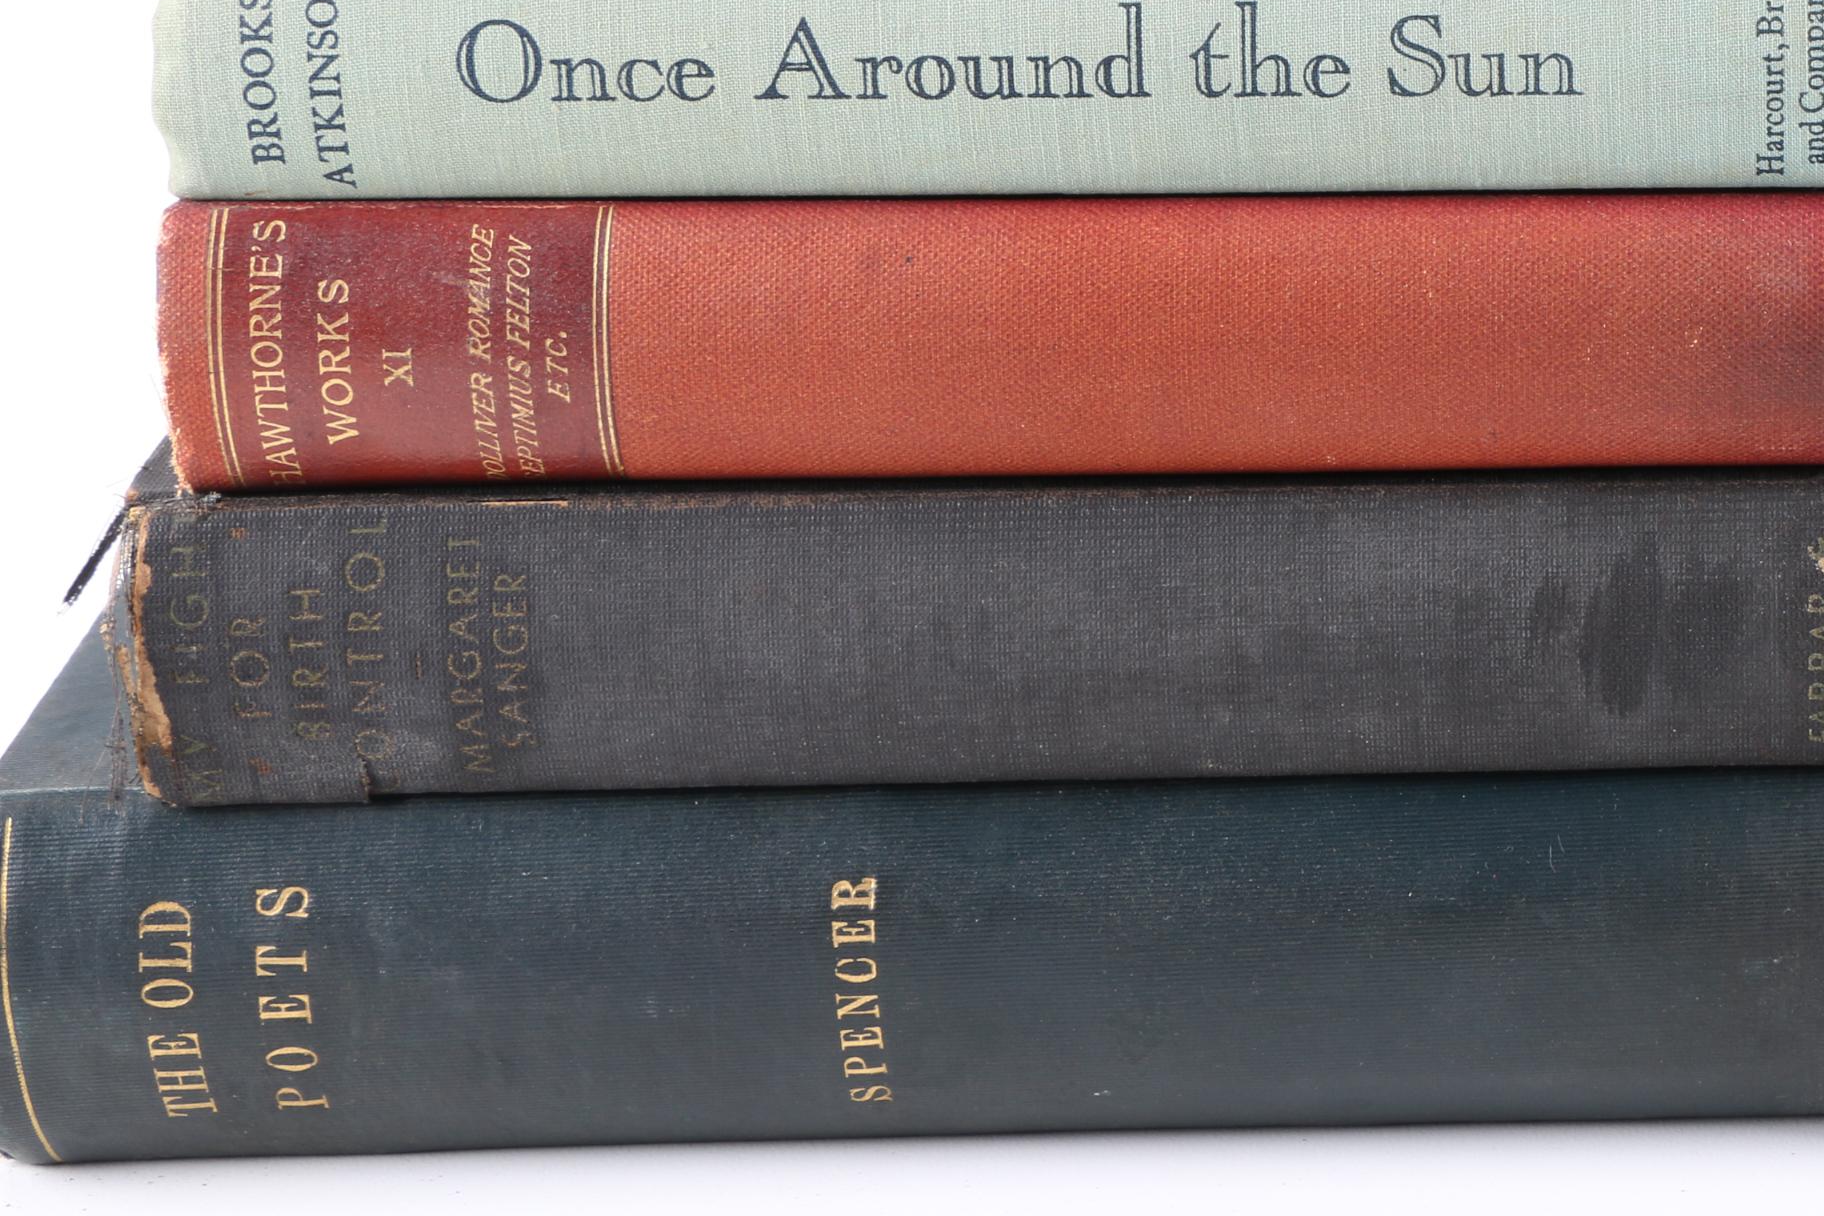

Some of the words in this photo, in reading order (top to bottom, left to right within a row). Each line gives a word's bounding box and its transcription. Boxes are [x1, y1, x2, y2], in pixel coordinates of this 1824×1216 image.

[455, 18, 716, 104] Once
[753, 0, 1152, 102] Around
[1189, 0, 1352, 99] the
[1386, 13, 1583, 98] Sun
[1755, 42, 1791, 177] Harcourt,
[316, 278, 361, 445] WORKS
[466, 223, 496, 364] ROMANCE
[504, 233, 534, 352] FELTON
[381, 346, 415, 387] XI
[544, 329, 572, 404] ETC.
[229, 614, 273, 719] FOR
[288, 586, 335, 742] BIRTH
[344, 512, 399, 774] ONTROL
[447, 535, 495, 774] MARGARET
[492, 573, 538, 750] SANGER
[138, 900, 194, 1010] OLD
[254, 885, 332, 1111] POETS
[830, 874, 894, 1103] SPENCER
[147, 1032, 218, 1119] THE
